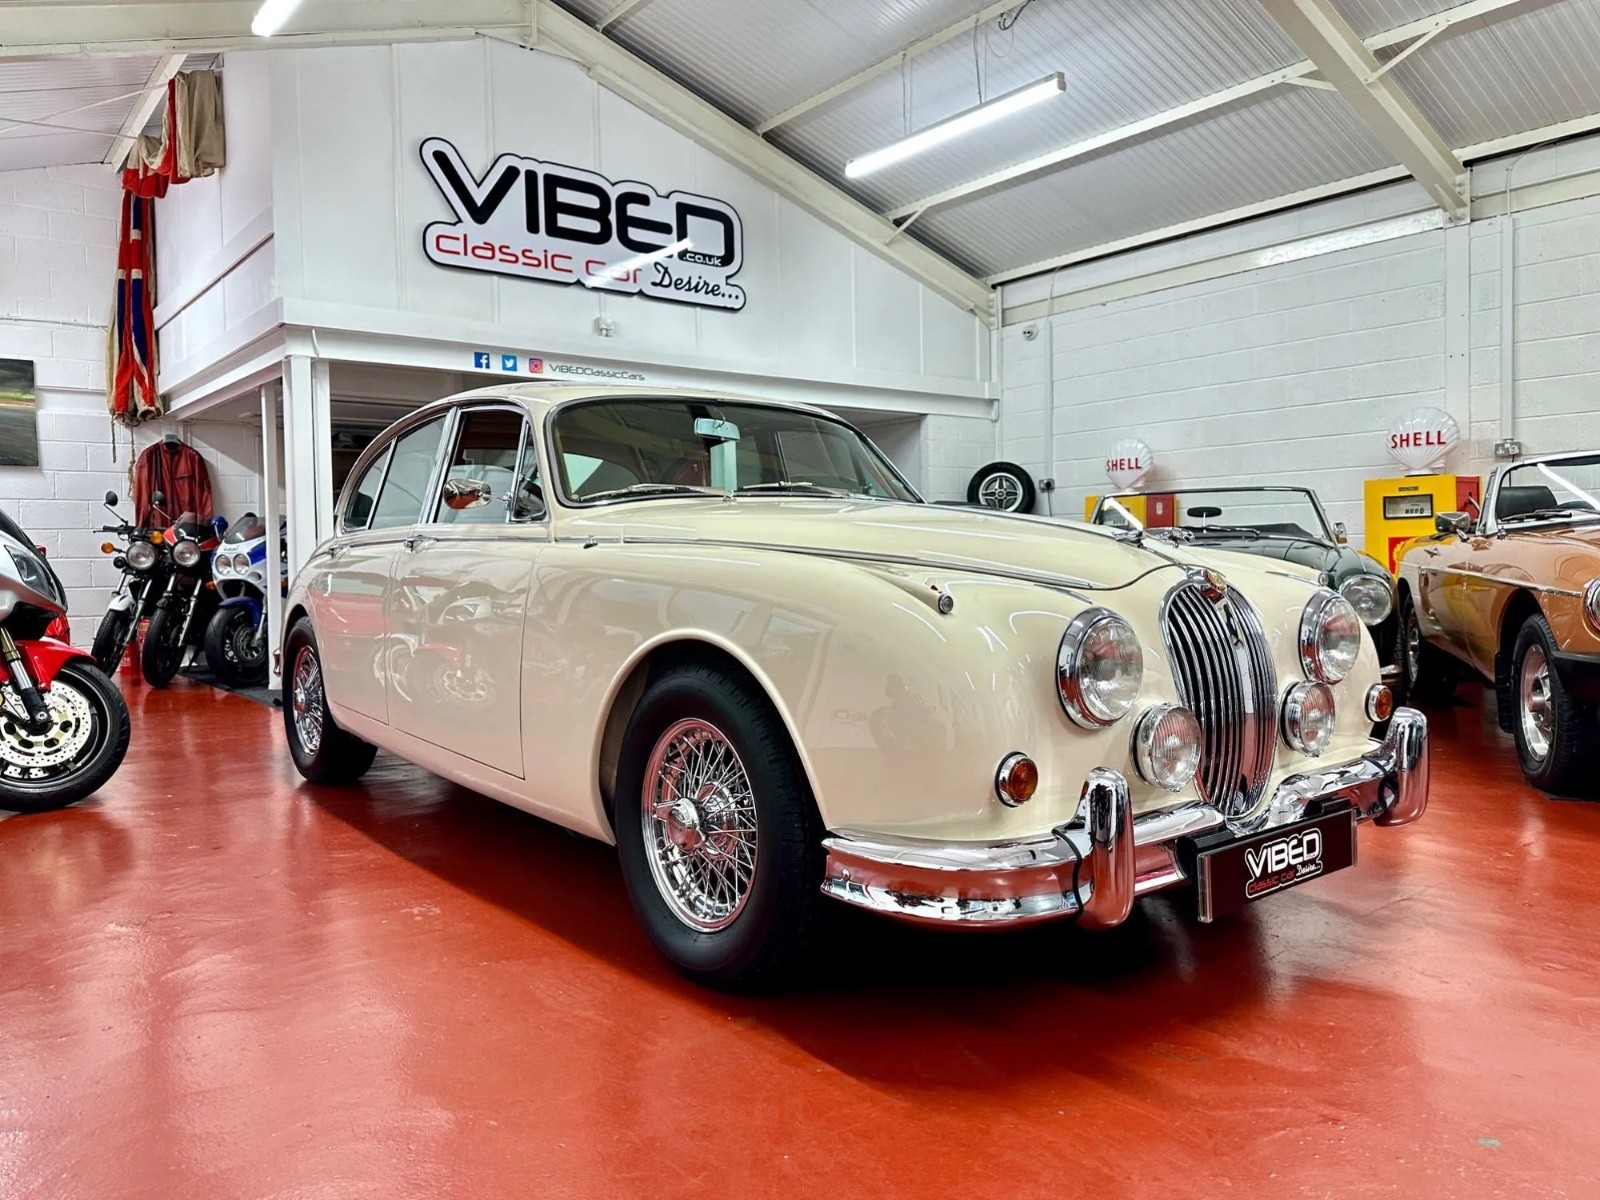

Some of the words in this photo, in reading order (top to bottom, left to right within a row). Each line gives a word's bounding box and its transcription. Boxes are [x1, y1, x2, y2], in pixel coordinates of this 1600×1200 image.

[432, 149, 735, 268] VIBED
[683, 252, 722, 267] .co.uk
[650, 261, 739, 300] Desire...
[1391, 430, 1446, 449] SHELL
[1106, 457, 1142, 472] SHELL
[1247, 833, 1320, 877] VIBED
